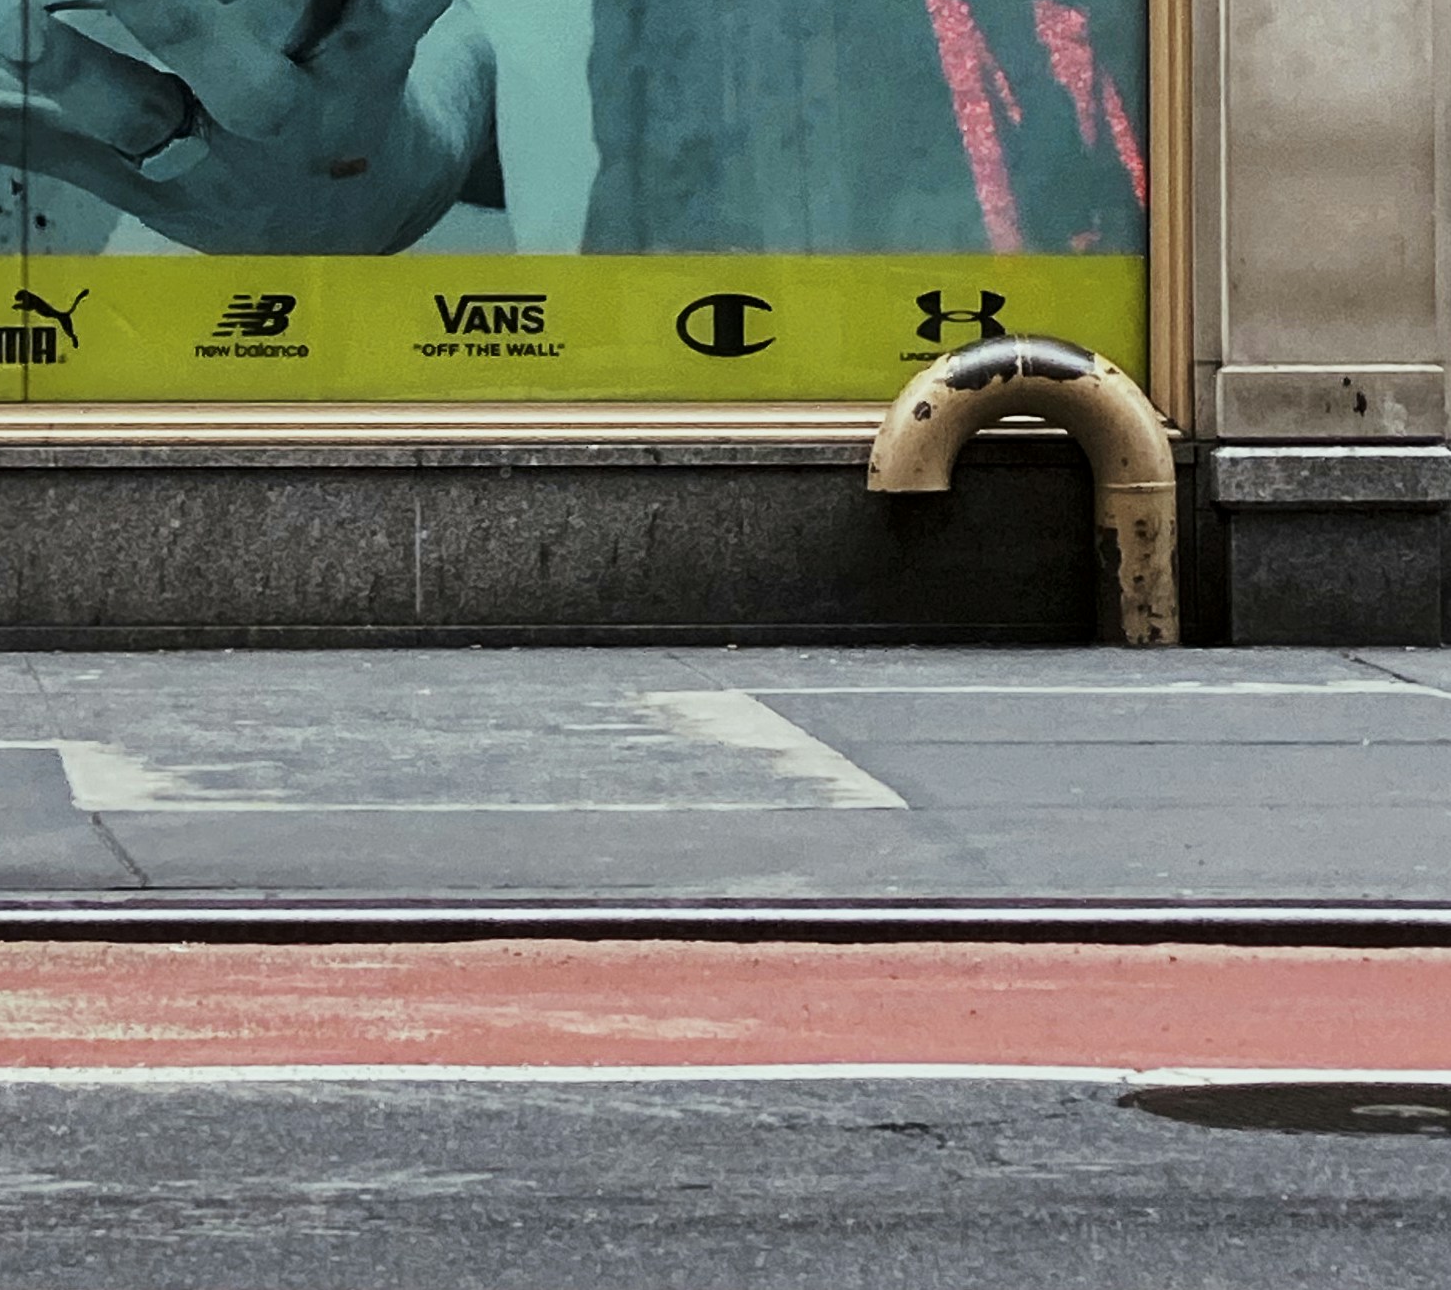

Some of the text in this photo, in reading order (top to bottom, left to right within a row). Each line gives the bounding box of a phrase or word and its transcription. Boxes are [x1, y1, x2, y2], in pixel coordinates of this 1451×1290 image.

[434, 294, 547, 334] VANS
[194, 342, 310, 358] new balance
[464, 343, 501, 357] THE
